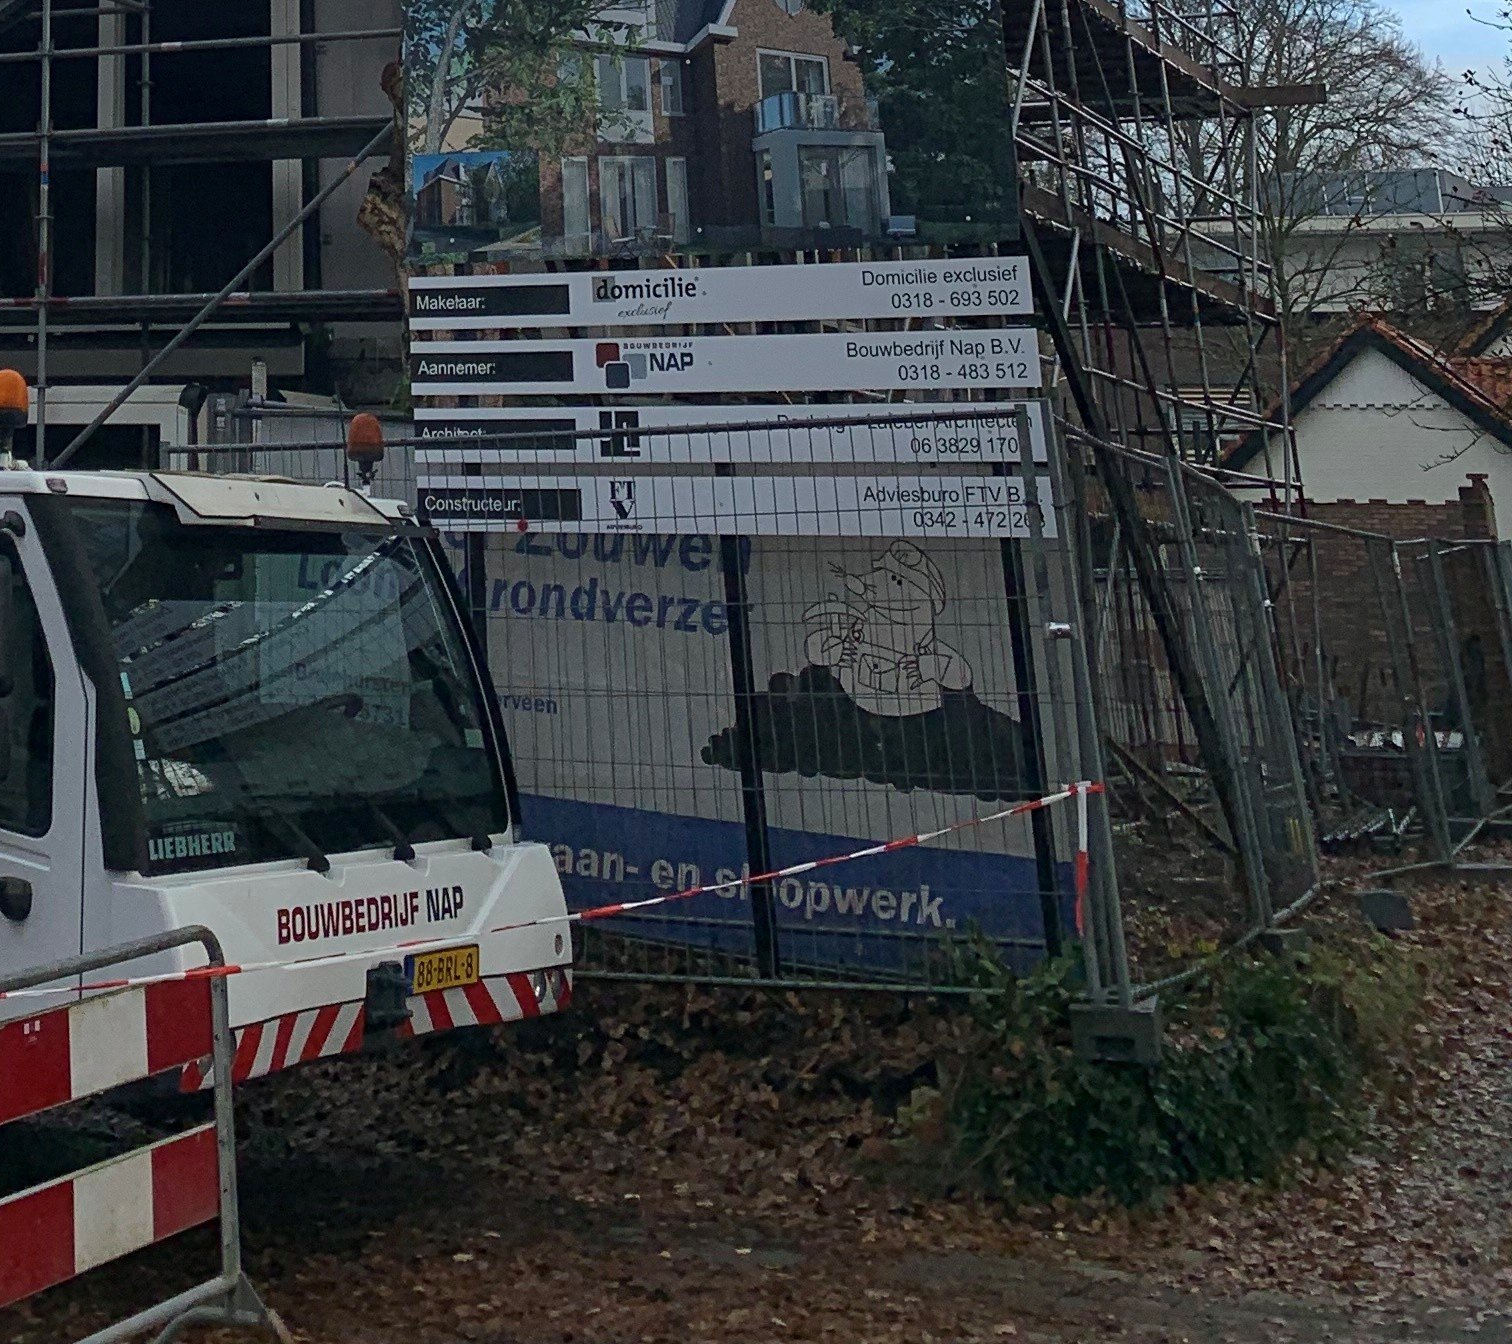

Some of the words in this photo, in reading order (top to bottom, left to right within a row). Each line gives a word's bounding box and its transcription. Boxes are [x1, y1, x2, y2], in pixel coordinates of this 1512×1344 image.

[861, 266, 940, 287] Domicilie
[944, 264, 1019, 285] exclusief
[595, 276, 698, 300] domicilie
[891, 289, 934, 310] 0318
[950, 288, 984, 308] 693
[987, 287, 1020, 307] 502
[415, 293, 486, 312] Makelaar:
[845, 339, 946, 360] Bouwbedrijf
[950, 338, 986, 362] Nap
[991, 337, 1026, 356] B.V.
[417, 358, 497, 376] Aannemer:
[649, 352, 694, 372] NAP
[897, 362, 941, 382] 0318
[957, 361, 991, 381] 483
[996, 360, 1029, 380] 512
[911, 436, 932, 454] 06
[937, 436, 980, 454] 3829
[424, 495, 522, 512] Constructeur:
[863, 485, 960, 503] Adviesburo
[964, 485, 1002, 503] FTV
[913, 511, 957, 528] 0342
[974, 511, 1007, 528] 472
[147, 830, 237, 862] LIEBHERR
[651, 859, 701, 892] en
[715, 862, 957, 929] slopwerk.
[276, 891, 421, 946] BOUWBEDRIJF
[425, 885, 465, 923] NAP
[415, 950, 475, 989] 88-BRL-8
